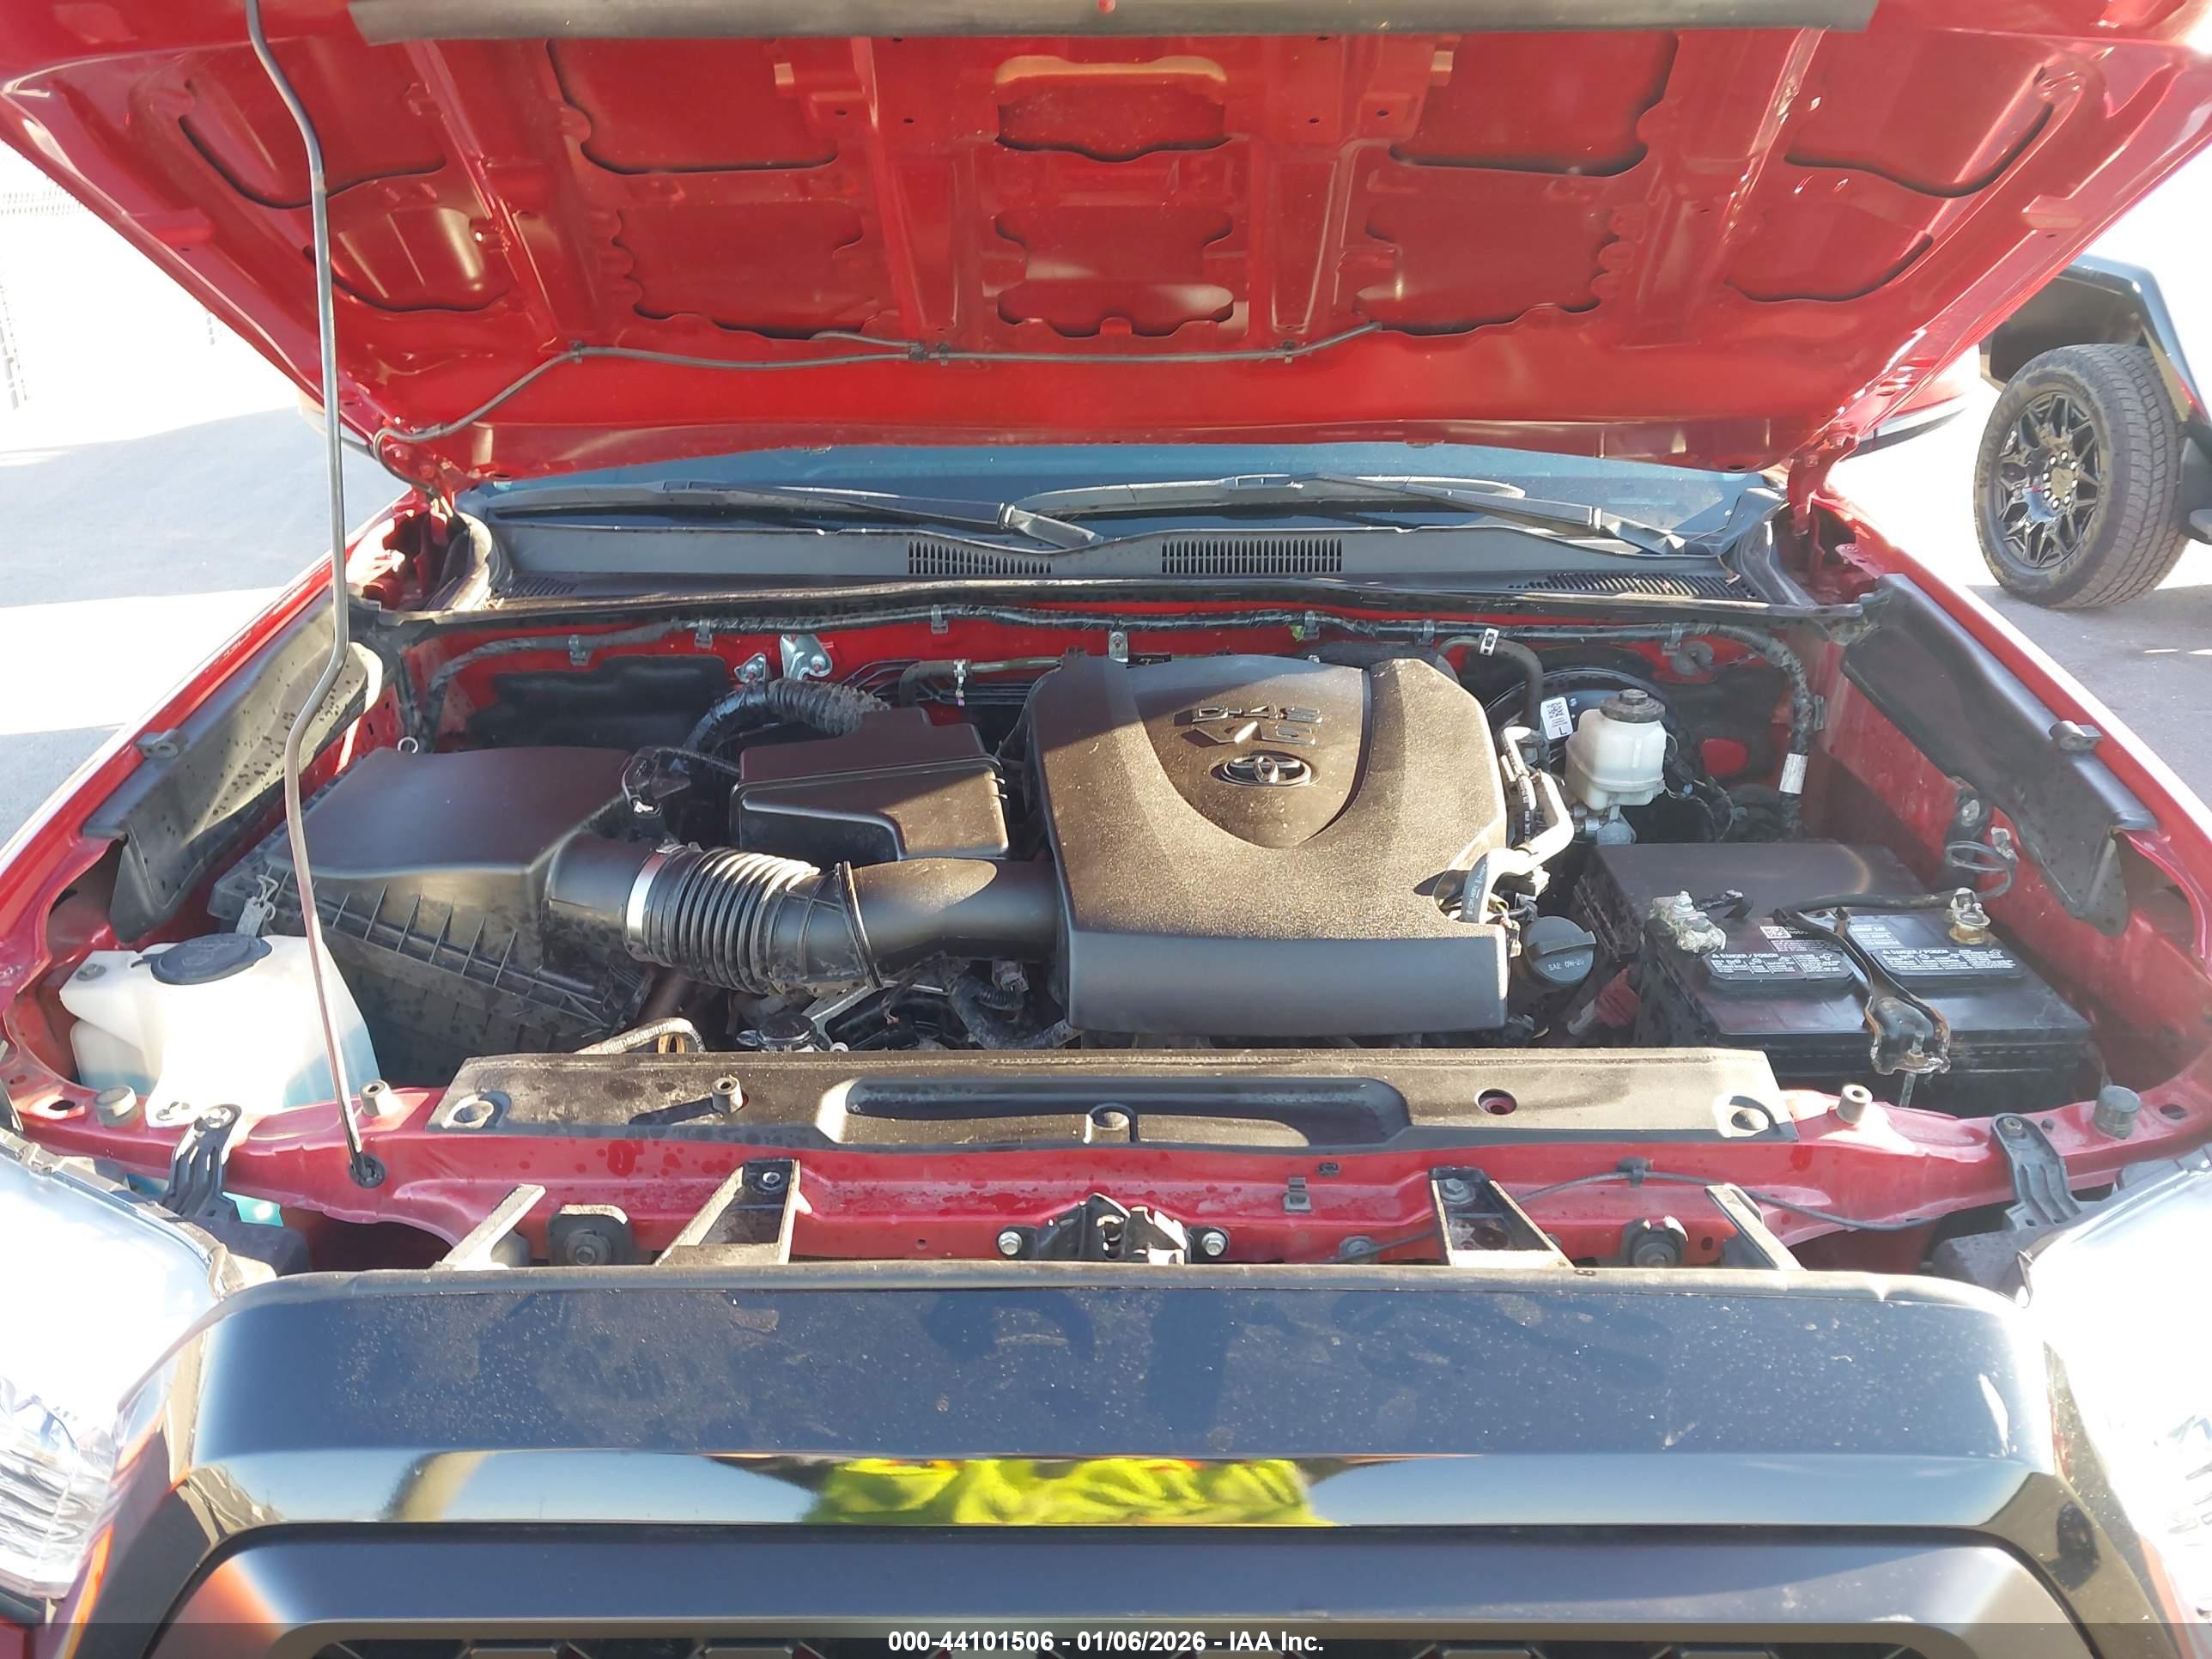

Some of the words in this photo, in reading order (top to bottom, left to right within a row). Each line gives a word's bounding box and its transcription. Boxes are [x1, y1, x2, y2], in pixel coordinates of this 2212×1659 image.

[1192, 706, 1323, 724] D-4S
[1194, 720, 1316, 745] V6
[1548, 962, 1562, 971] SAE
